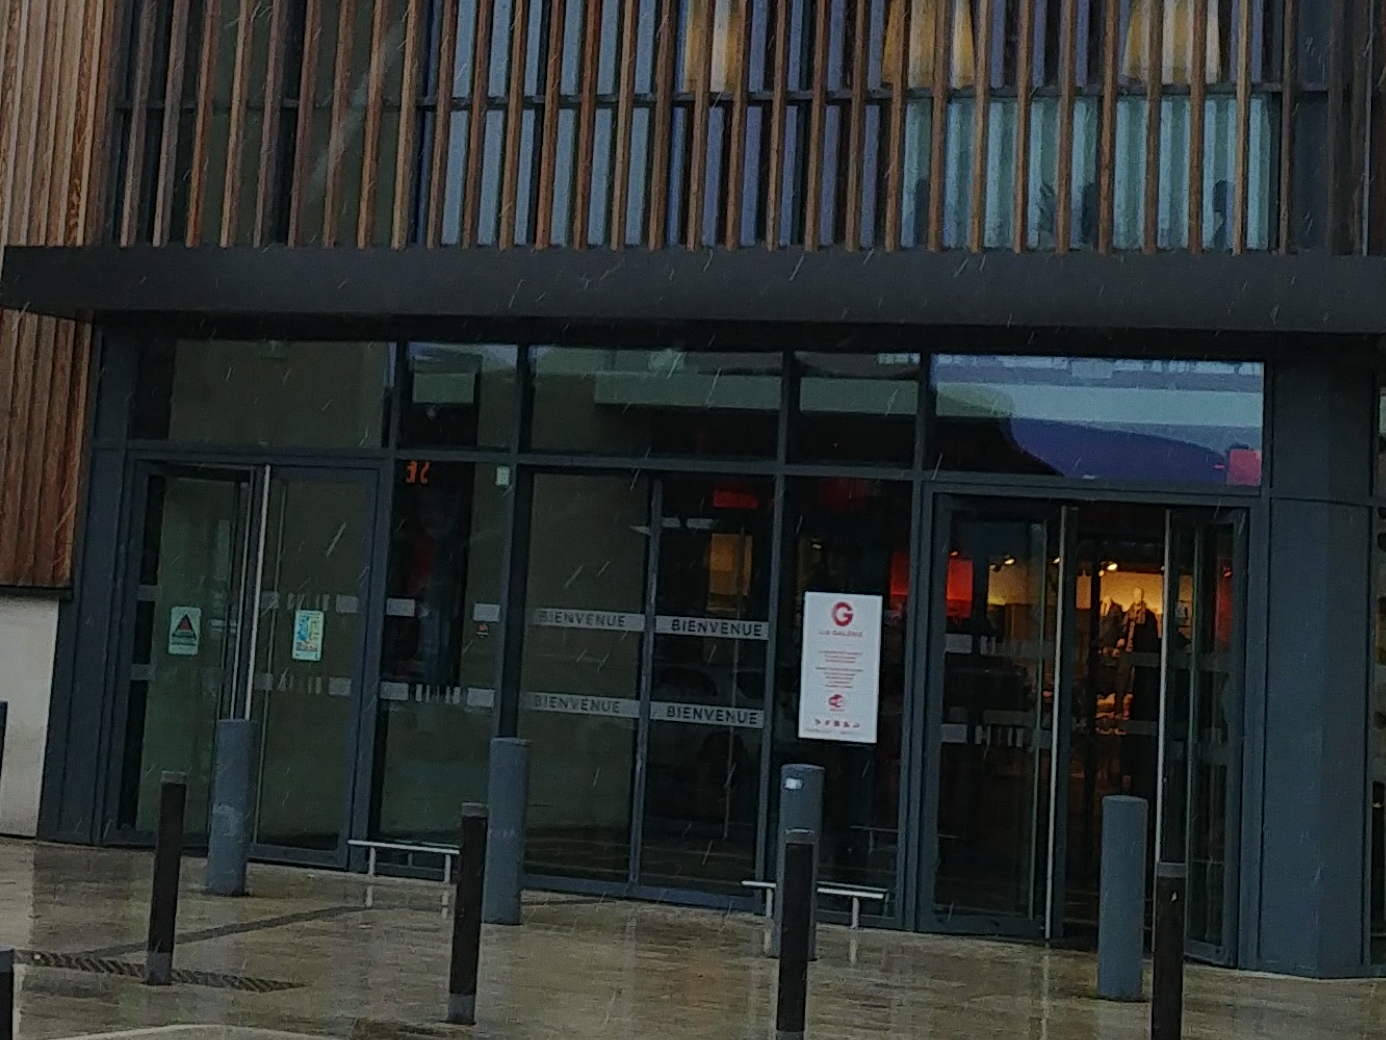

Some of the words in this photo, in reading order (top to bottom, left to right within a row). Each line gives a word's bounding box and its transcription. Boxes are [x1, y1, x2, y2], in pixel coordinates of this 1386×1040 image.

[537, 611, 626, 628] BIENVENUE
[671, 618, 763, 637] BIENVENUE
[534, 694, 621, 714] BIENVENUE
[666, 706, 759, 725] BIENVENUE
